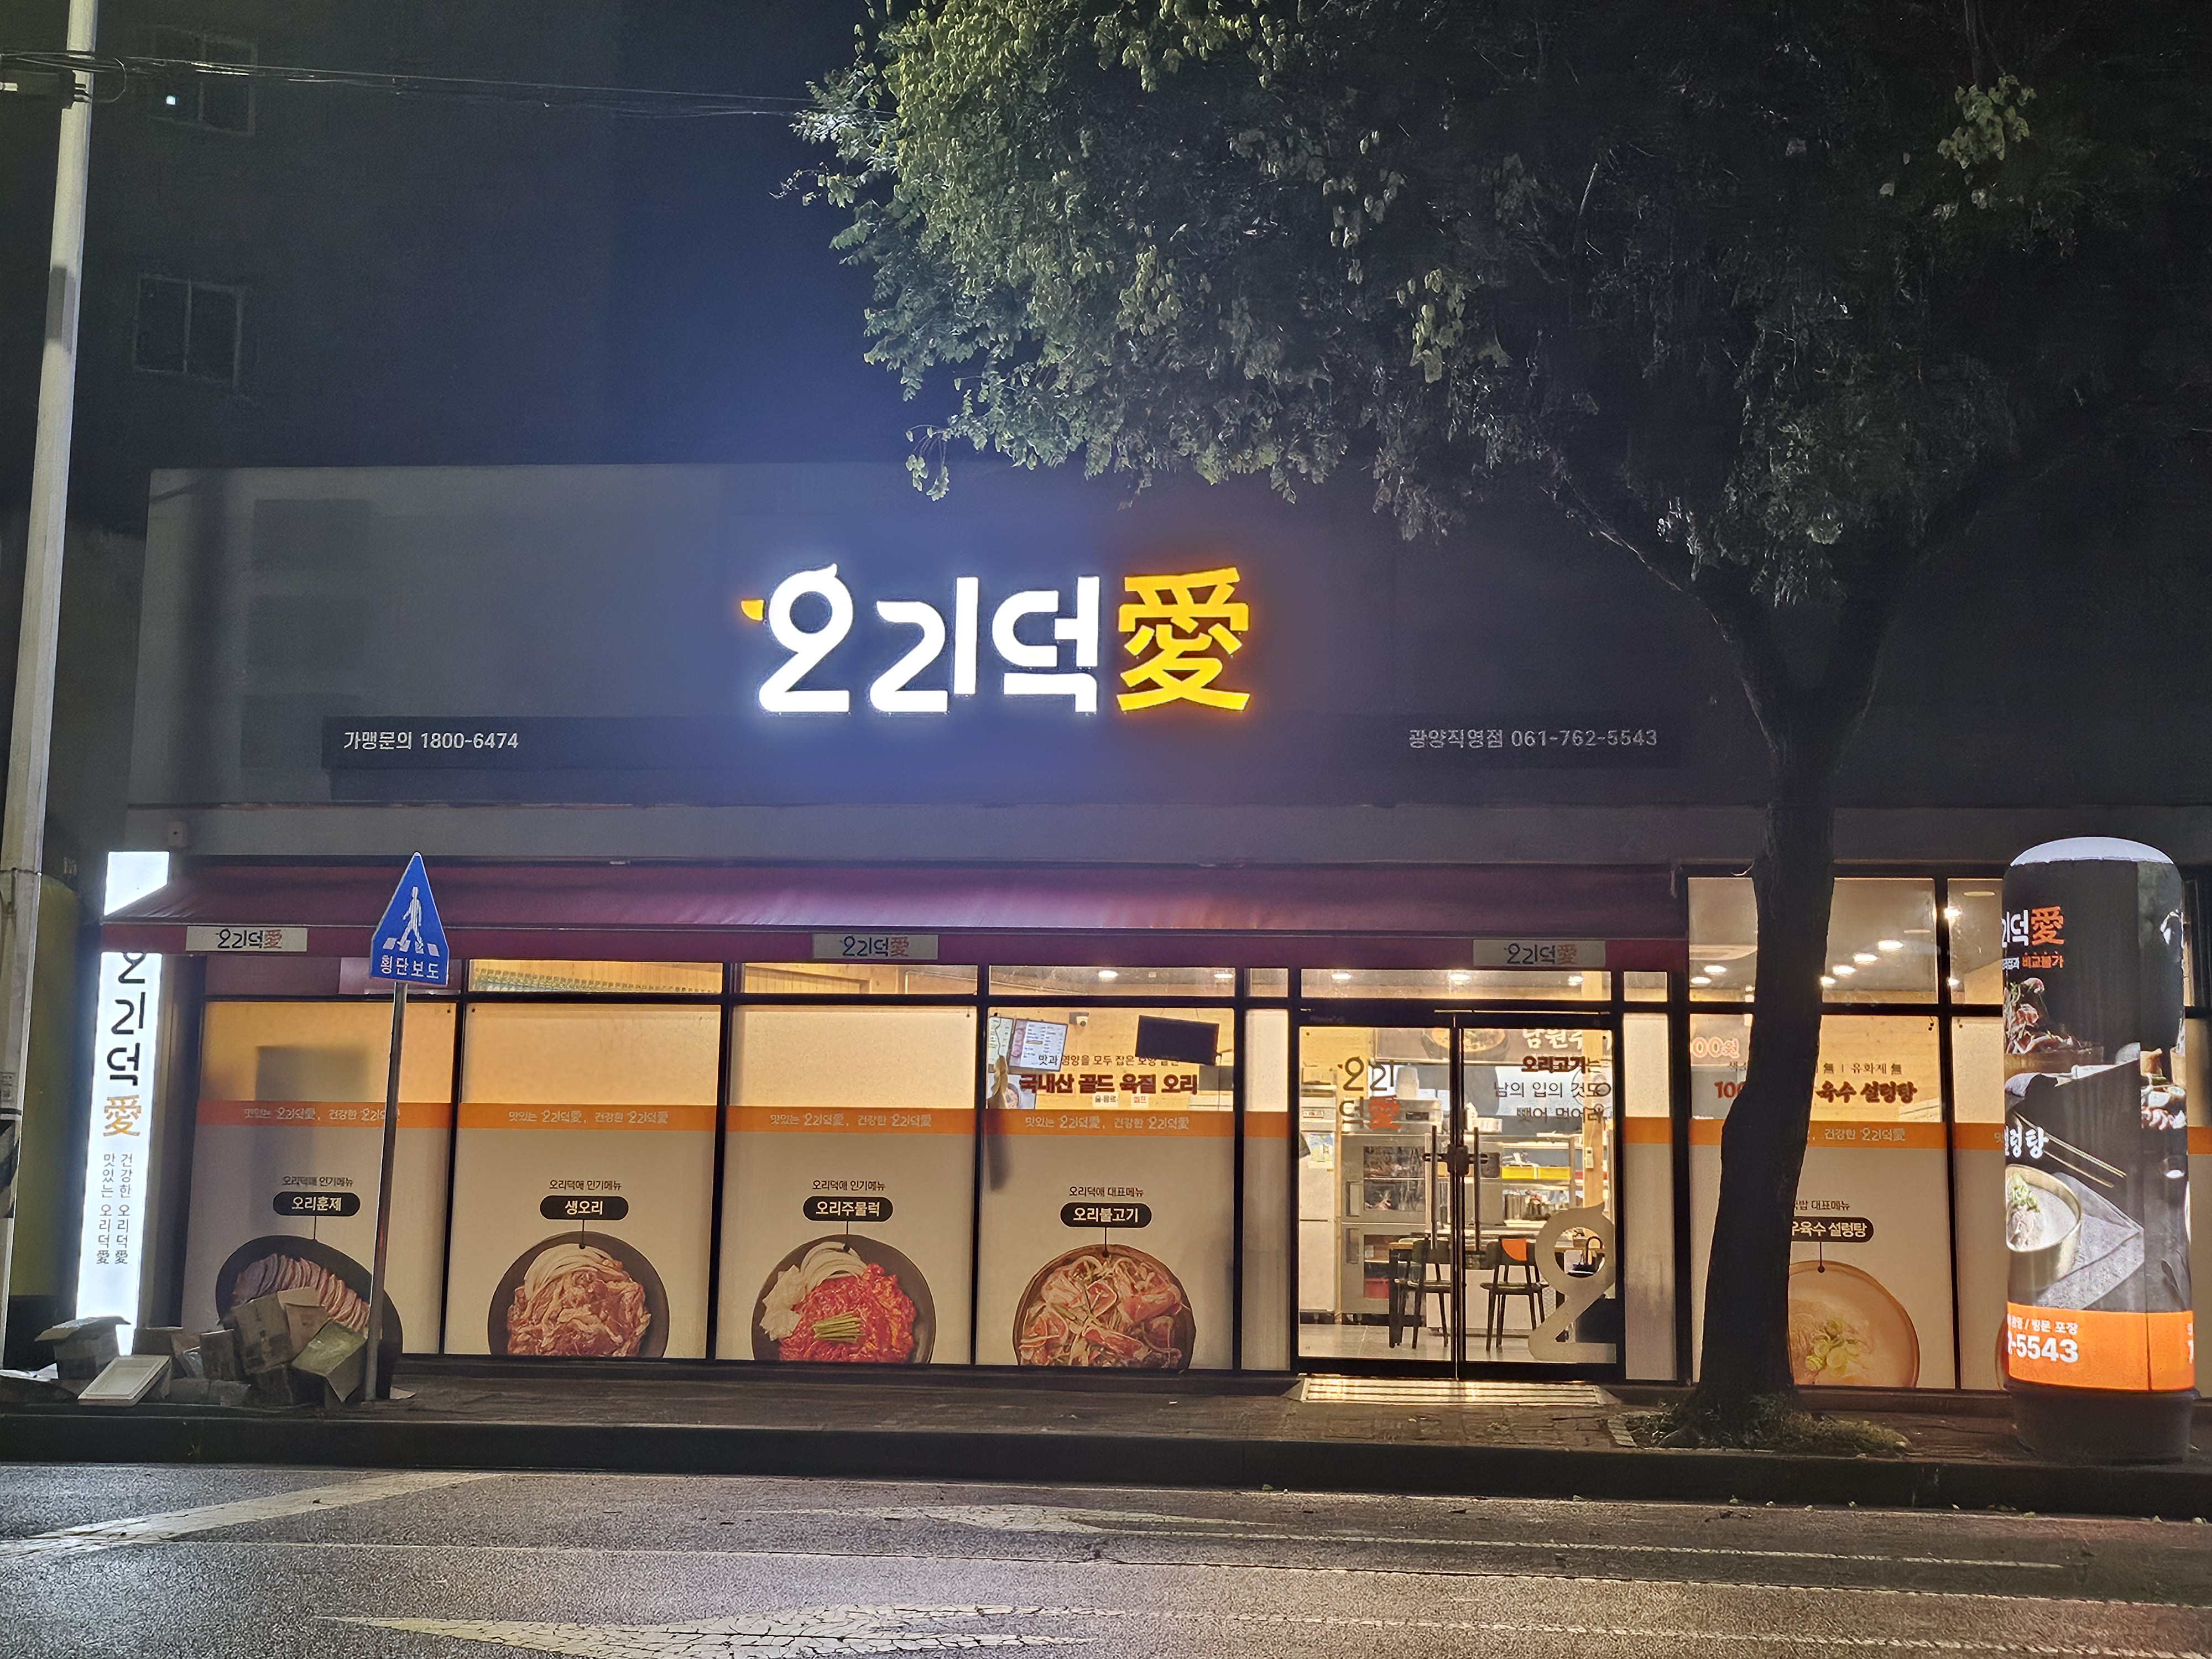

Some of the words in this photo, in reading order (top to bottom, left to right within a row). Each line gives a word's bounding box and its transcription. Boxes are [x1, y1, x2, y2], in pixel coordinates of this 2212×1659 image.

[343, 731, 413, 750] 가맹문의
[421, 732, 519, 749] 1800-6474
[1409, 729, 1503, 748] 광양직영점
[1511, 729, 1657, 747] 061-762-5543
[380, 956, 440, 979] 횡단보도
[1038, 1055, 1058, 1066] 맛과
[1093, 1055, 1112, 1066] 모두
[1115, 1055, 1134, 1066] 잡은
[1521, 1055, 1602, 1074] 오리고기는
[1851, 1063, 1887, 1074] 유화제
[1019, 1073, 1074, 1094] 국내산
[1078, 1074, 1115, 1094] 골드
[1120, 1073, 1156, 1094] 육질
[1161, 1074, 1198, 1095] 오리
[1495, 1082, 1524, 1098] 남의
[1532, 1082, 1562, 1098] 입의
[1815, 1081, 1857, 1103] 육수
[1860, 1081, 1918, 1104] 설렁탕
[101, 1153, 116, 1198] 맛있는
[119, 1153, 133, 1198] 건강한
[292, 1196, 342, 1212] 오리훈제
[565, 1200, 603, 1215] 생오리
[816, 1201, 880, 1217] 오리주물럭
[1811, 1200, 1850, 1211] 대표메뉴
[1073, 1207, 1138, 1223] 오리불고기
[96, 1204, 112, 1264] 오리덕愛
[114, 1204, 131, 1264] 오리덕愛
[1828, 1222, 1867, 1238] 설렁탕
[2055, 1321, 2079, 1335] 포장
